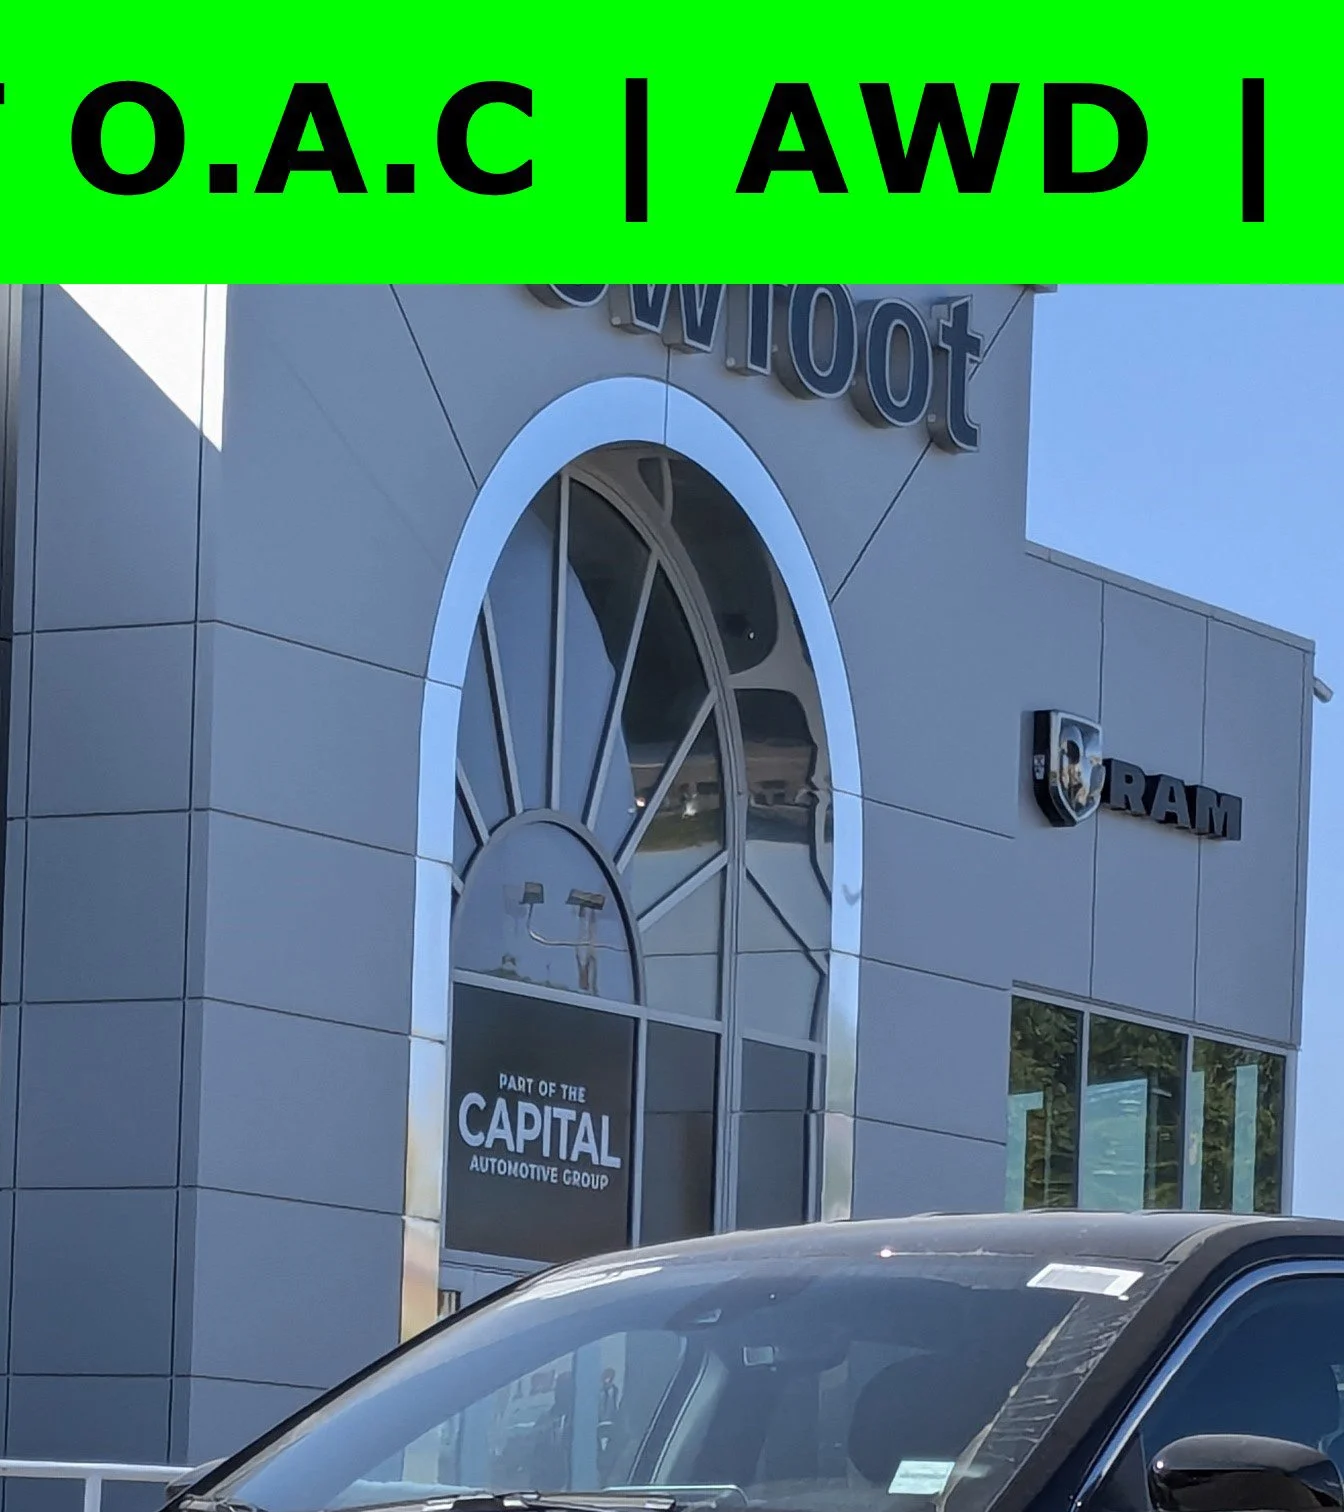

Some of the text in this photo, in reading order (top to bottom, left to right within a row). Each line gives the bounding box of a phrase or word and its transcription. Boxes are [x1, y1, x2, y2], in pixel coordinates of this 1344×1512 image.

[1103, 758, 1243, 842] RAM
[499, 1072, 587, 1103] PART OF THE
[458, 1092, 622, 1169] CAPITAL
[469, 1154, 609, 1191] AUTOMOTIVE GROUP
